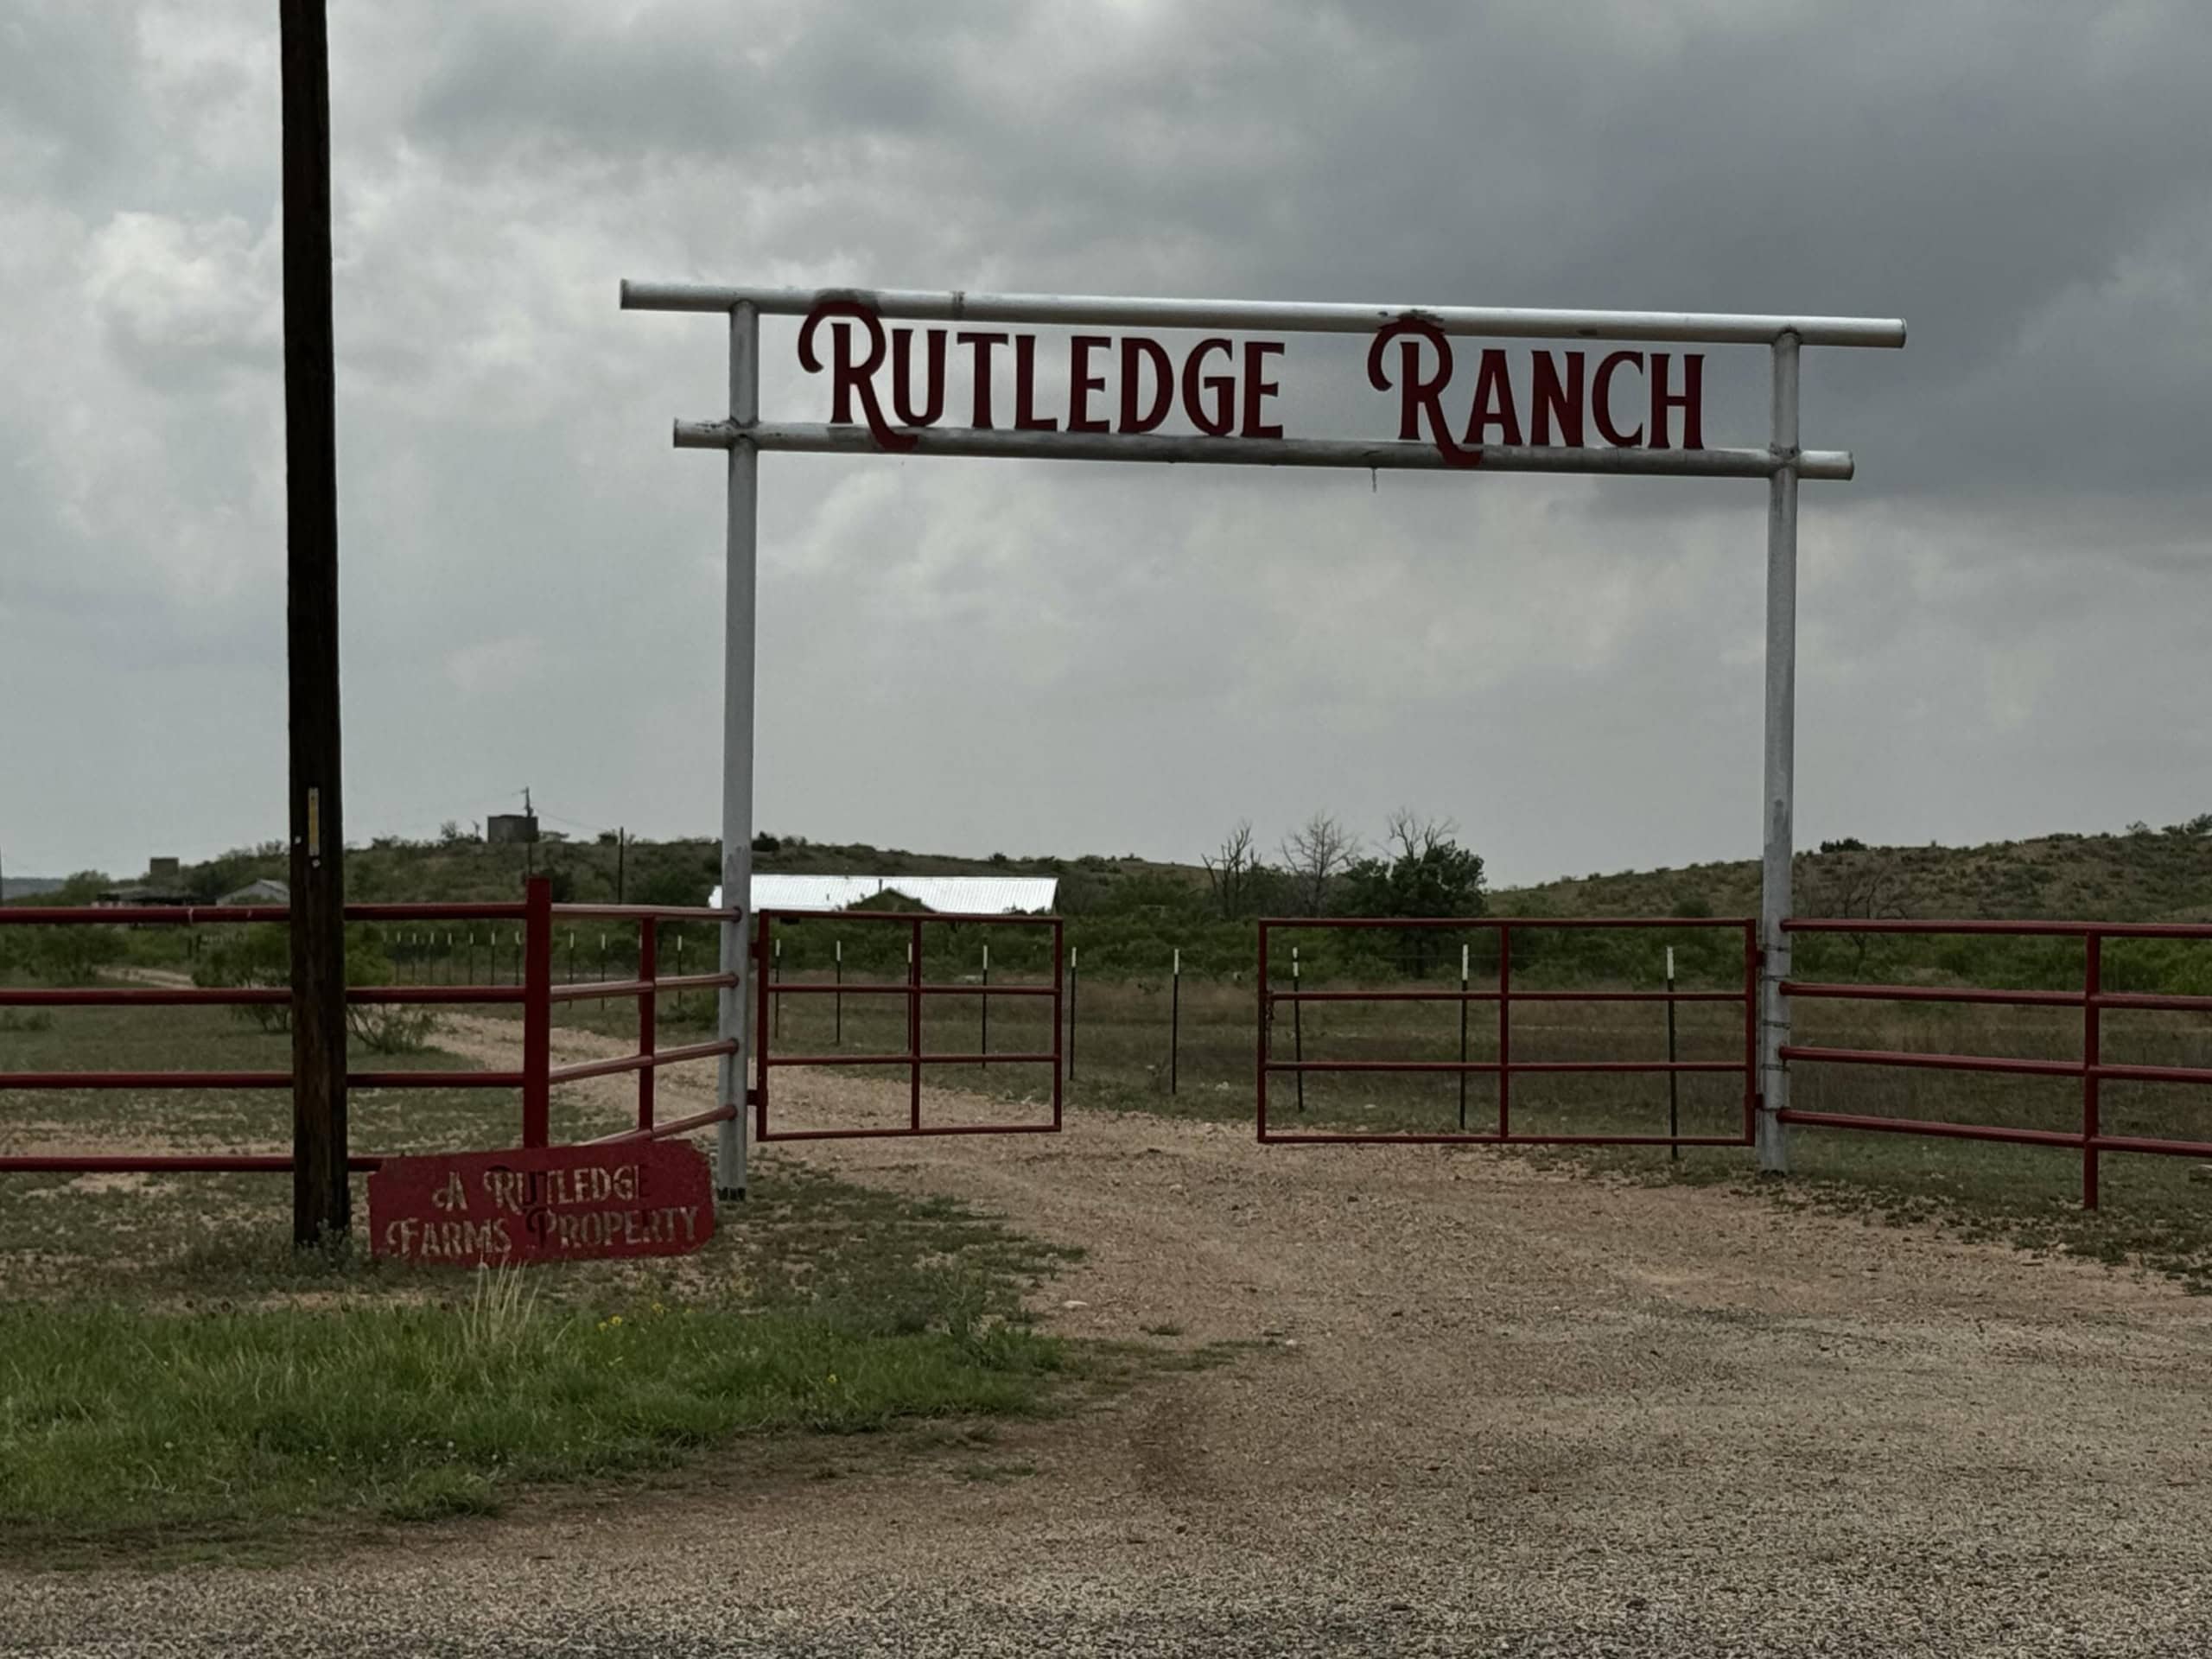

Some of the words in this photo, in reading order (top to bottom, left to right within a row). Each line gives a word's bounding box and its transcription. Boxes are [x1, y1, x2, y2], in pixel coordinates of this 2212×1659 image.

[798, 300, 1286, 451] RUTLEDGE
[1367, 315, 1705, 467] RANCH
[433, 1171, 467, 1211] A
[385, 1217, 512, 1258] FARMS
[526, 1205, 698, 1249] PROPERTY
